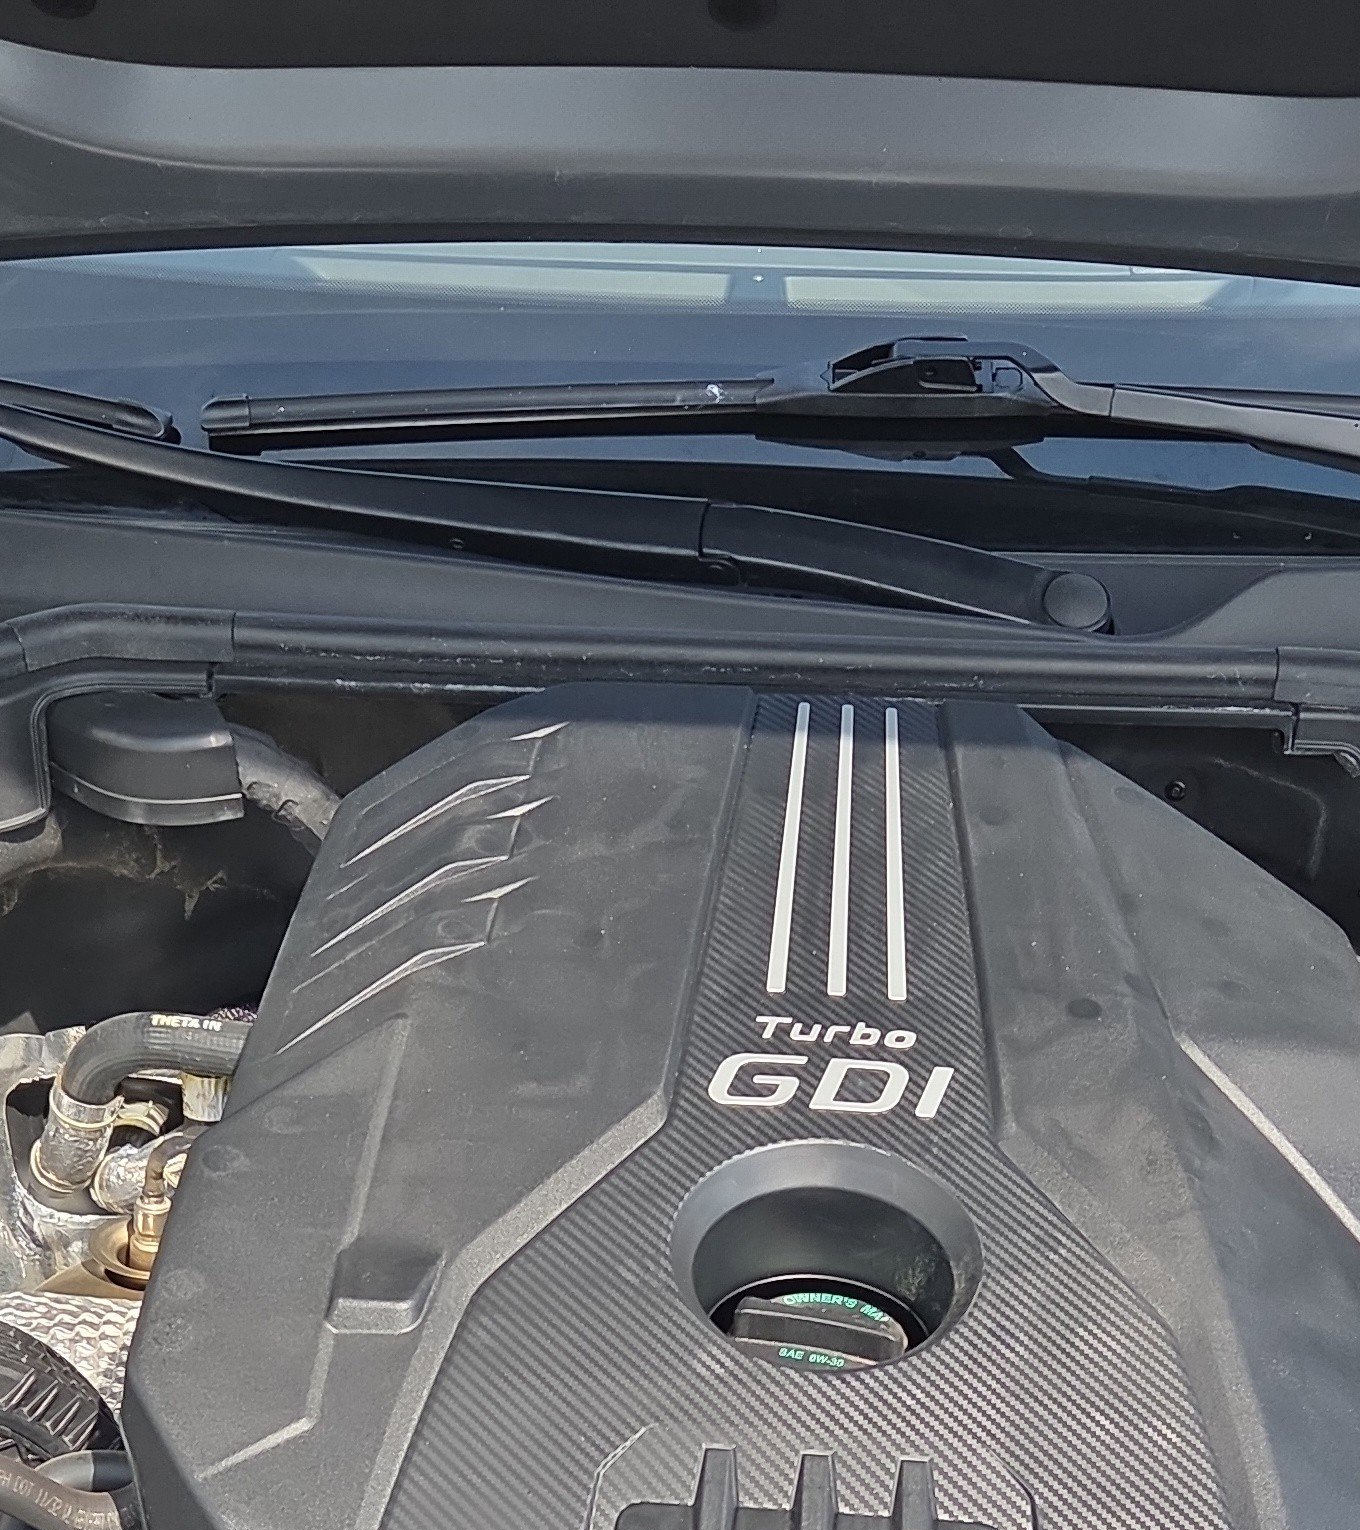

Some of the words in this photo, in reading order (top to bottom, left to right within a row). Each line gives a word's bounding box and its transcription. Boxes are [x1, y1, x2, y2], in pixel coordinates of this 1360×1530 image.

[150, 1013, 200, 1028] THETA
[754, 1014, 918, 1050] Turbo
[706, 1051, 956, 1120] GDI
[782, 1292, 858, 1309] OWNER'S
[778, 1347, 805, 1361] SAE
[808, 1353, 845, 1368] 0W-30
